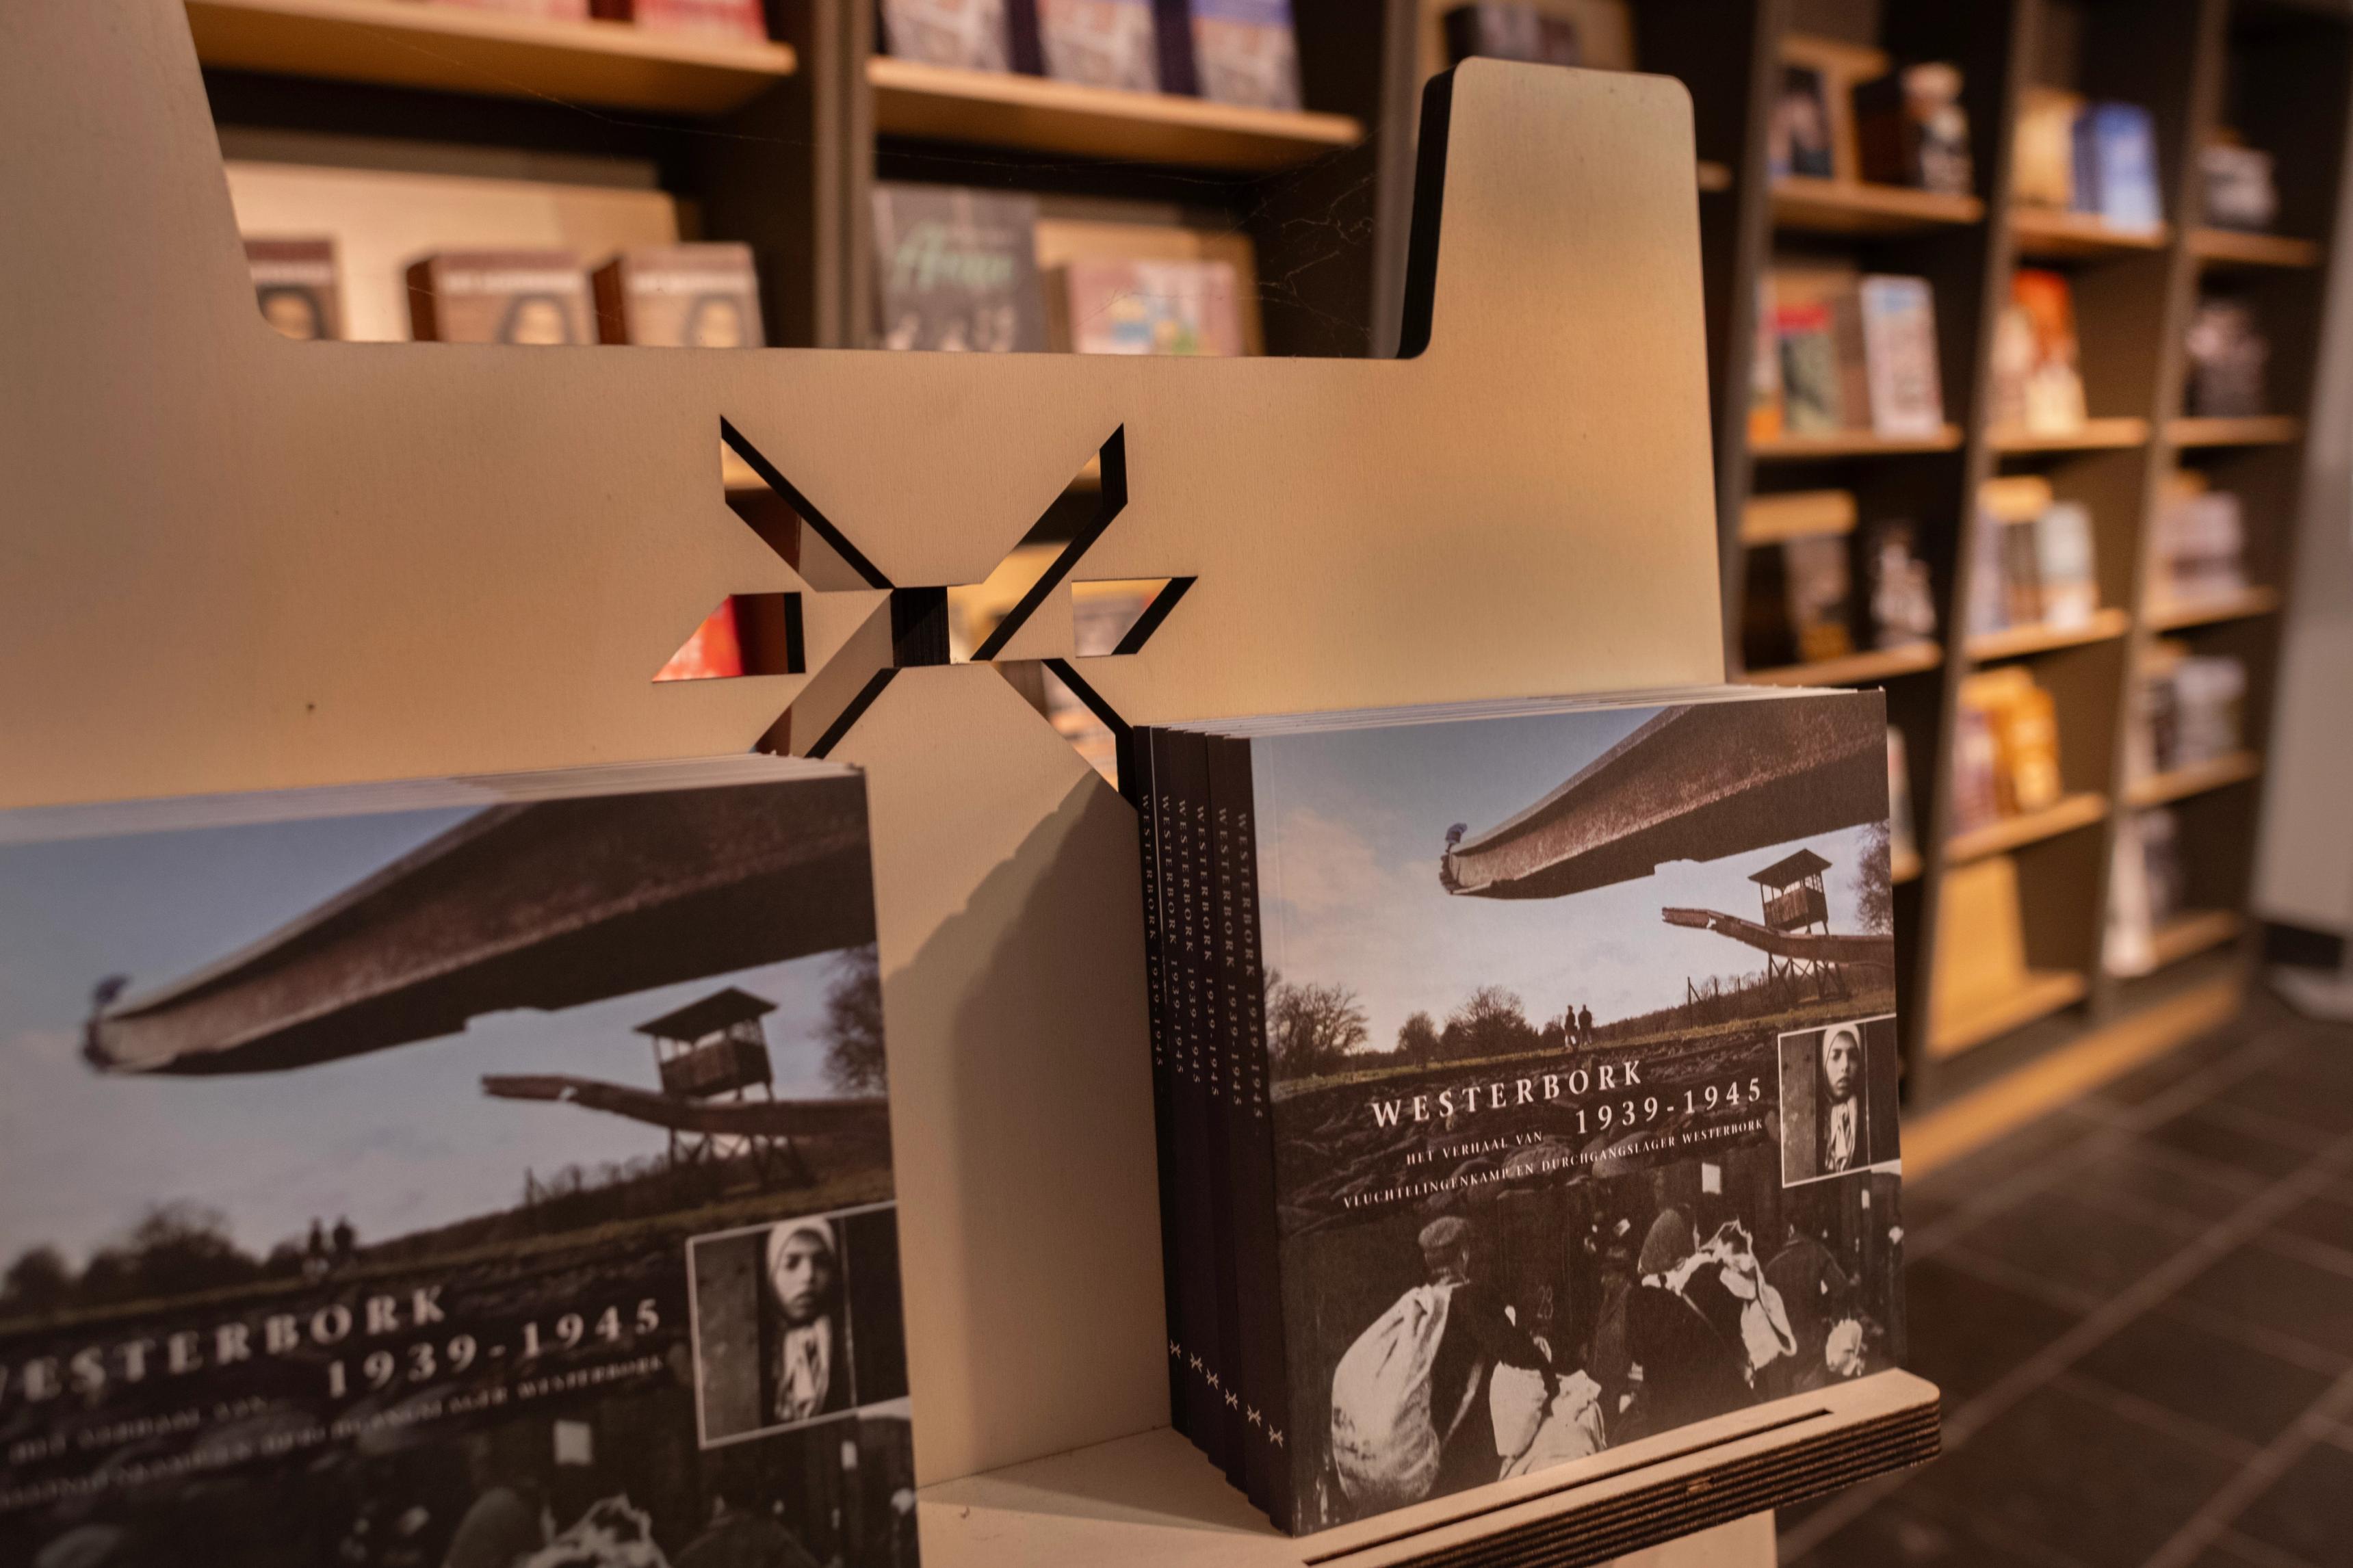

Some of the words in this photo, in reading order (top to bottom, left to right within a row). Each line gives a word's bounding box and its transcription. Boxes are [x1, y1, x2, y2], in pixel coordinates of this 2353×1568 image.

[1143, 794, 1156, 940] WESTERBORK
[1151, 956, 1163, 1066] 1939-1945
[1162, 796, 1177, 944] WESTERBORK
[1171, 960, 1184, 1073] 1939-1945
[1179, 800, 1193, 952] WESTERBORK
[1187, 967, 1200, 1083] 1939-1945
[1197, 805, 1212, 961] WESTERBORK
[1206, 977, 1219, 1095] 1939-1945
[1219, 807, 1234, 967] WESTERBORK
[1228, 984, 1242, 1105] 1939-1945
[1238, 813, 1255, 977] WESTERBORK
[1247, 994, 1263, 1119] 1939-1945
[1343, 1168, 1509, 1209] VLUCHTELINGENKAMP
[1516, 1164, 1533, 1177] EN
[1542, 1136, 1676, 1172] DURCHGANGSLAGER
[1682, 1118, 1763, 1145] WESTERBORK
[1372, 1060, 1641, 1128] WESTERBORK
[1407, 1149, 1434, 1166] HET
[1442, 1137, 1508, 1159] VERHAAL
[1516, 1131, 1542, 1146] VAN
[1575, 1077, 1760, 1134] 1939-1945
[0, 1285, 445, 1403] ESTERBORK
[328, 1298, 660, 1399] 1939-1945
